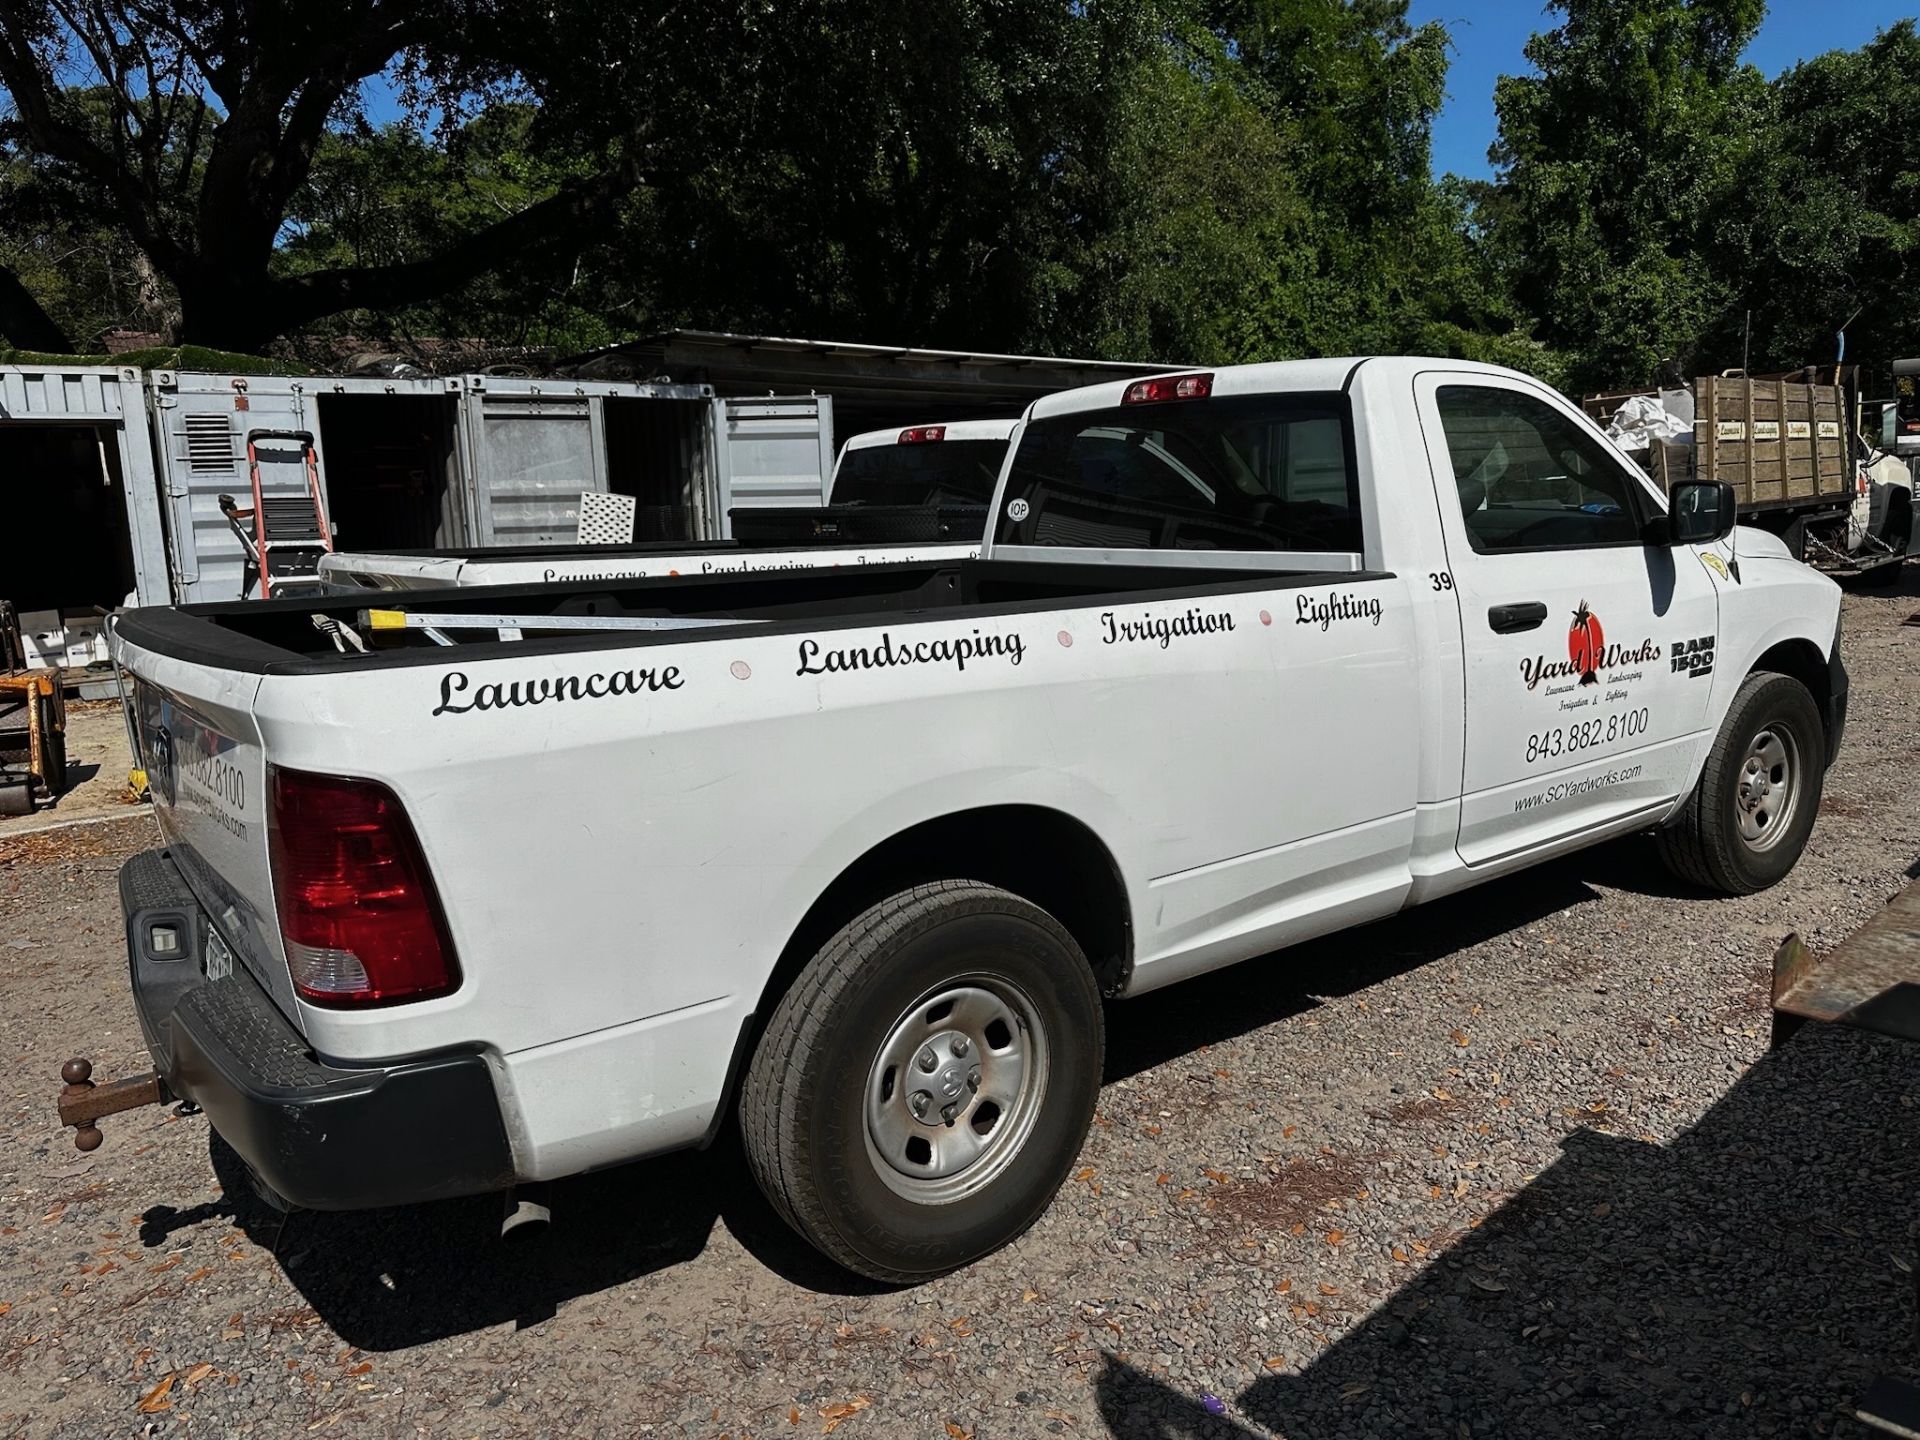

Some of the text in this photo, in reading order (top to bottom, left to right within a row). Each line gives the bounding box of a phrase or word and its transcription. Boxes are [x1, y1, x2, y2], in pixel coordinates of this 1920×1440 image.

[1429, 572, 1453, 591] 39
[433, 592, 1384, 717] Lawncare Landscaping Irrigation Lighting
[1671, 635, 1715, 657] RAM
[1520, 637, 1661, 691] Yard Works
[1671, 651, 1714, 673] 1500
[1545, 670, 1642, 696] Lawncare Landscaping
[1558, 699, 1588, 712] Irrigation
[1605, 689, 1628, 703] Lighting
[1526, 707, 1649, 763] 843.882.8100
[1513, 763, 1642, 812] www.SCYardworks.com
